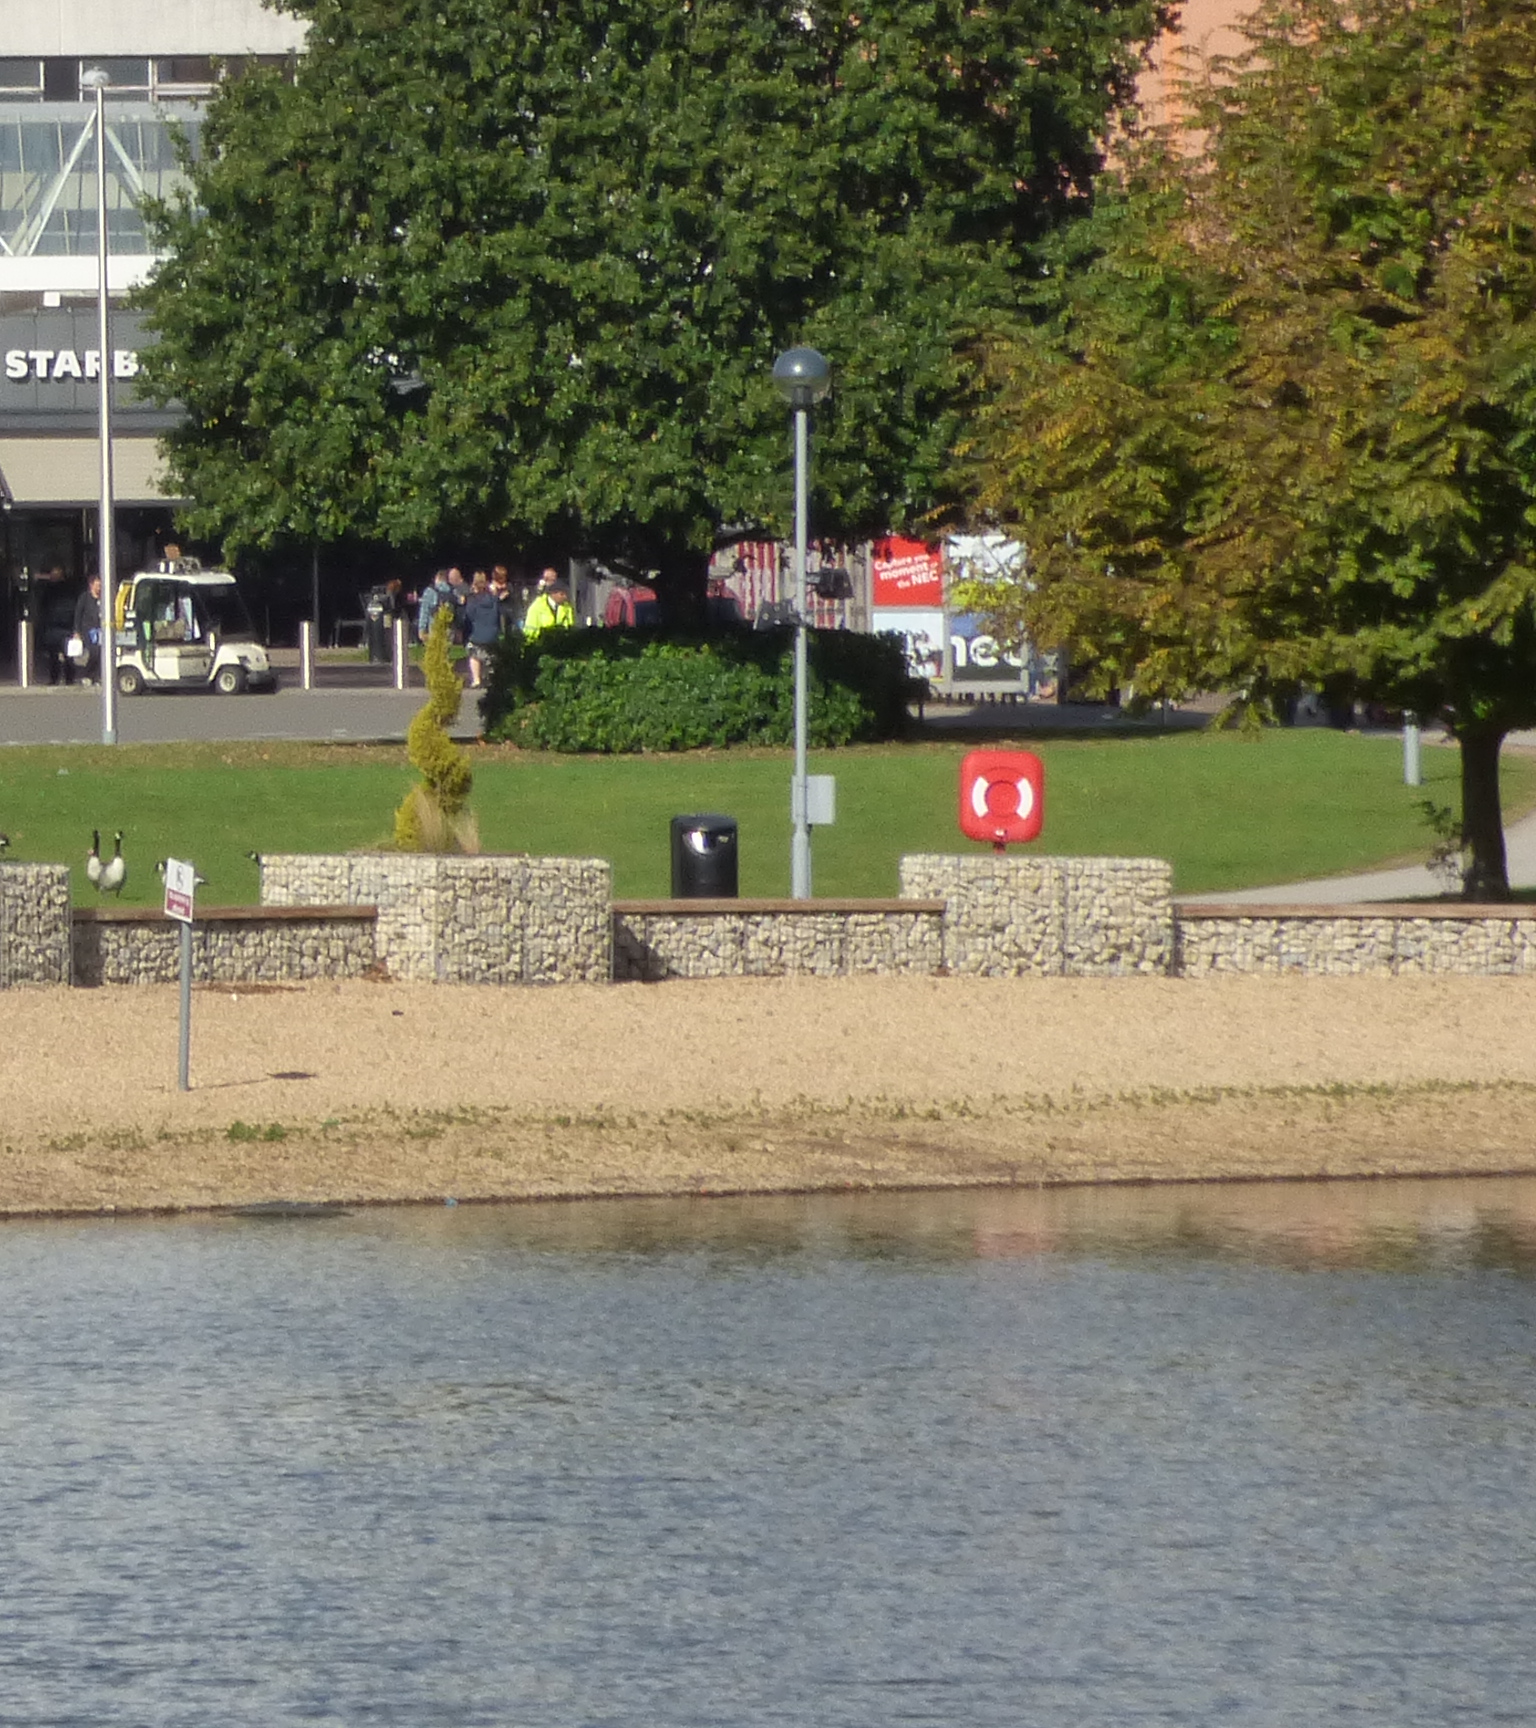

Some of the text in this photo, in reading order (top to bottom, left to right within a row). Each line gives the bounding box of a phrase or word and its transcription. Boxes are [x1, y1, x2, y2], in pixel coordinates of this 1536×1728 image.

[5, 350, 150, 378] STARB
[874, 557, 912, 571] Capture
[880, 562, 928, 581] moment
[912, 570, 939, 585] NEC
